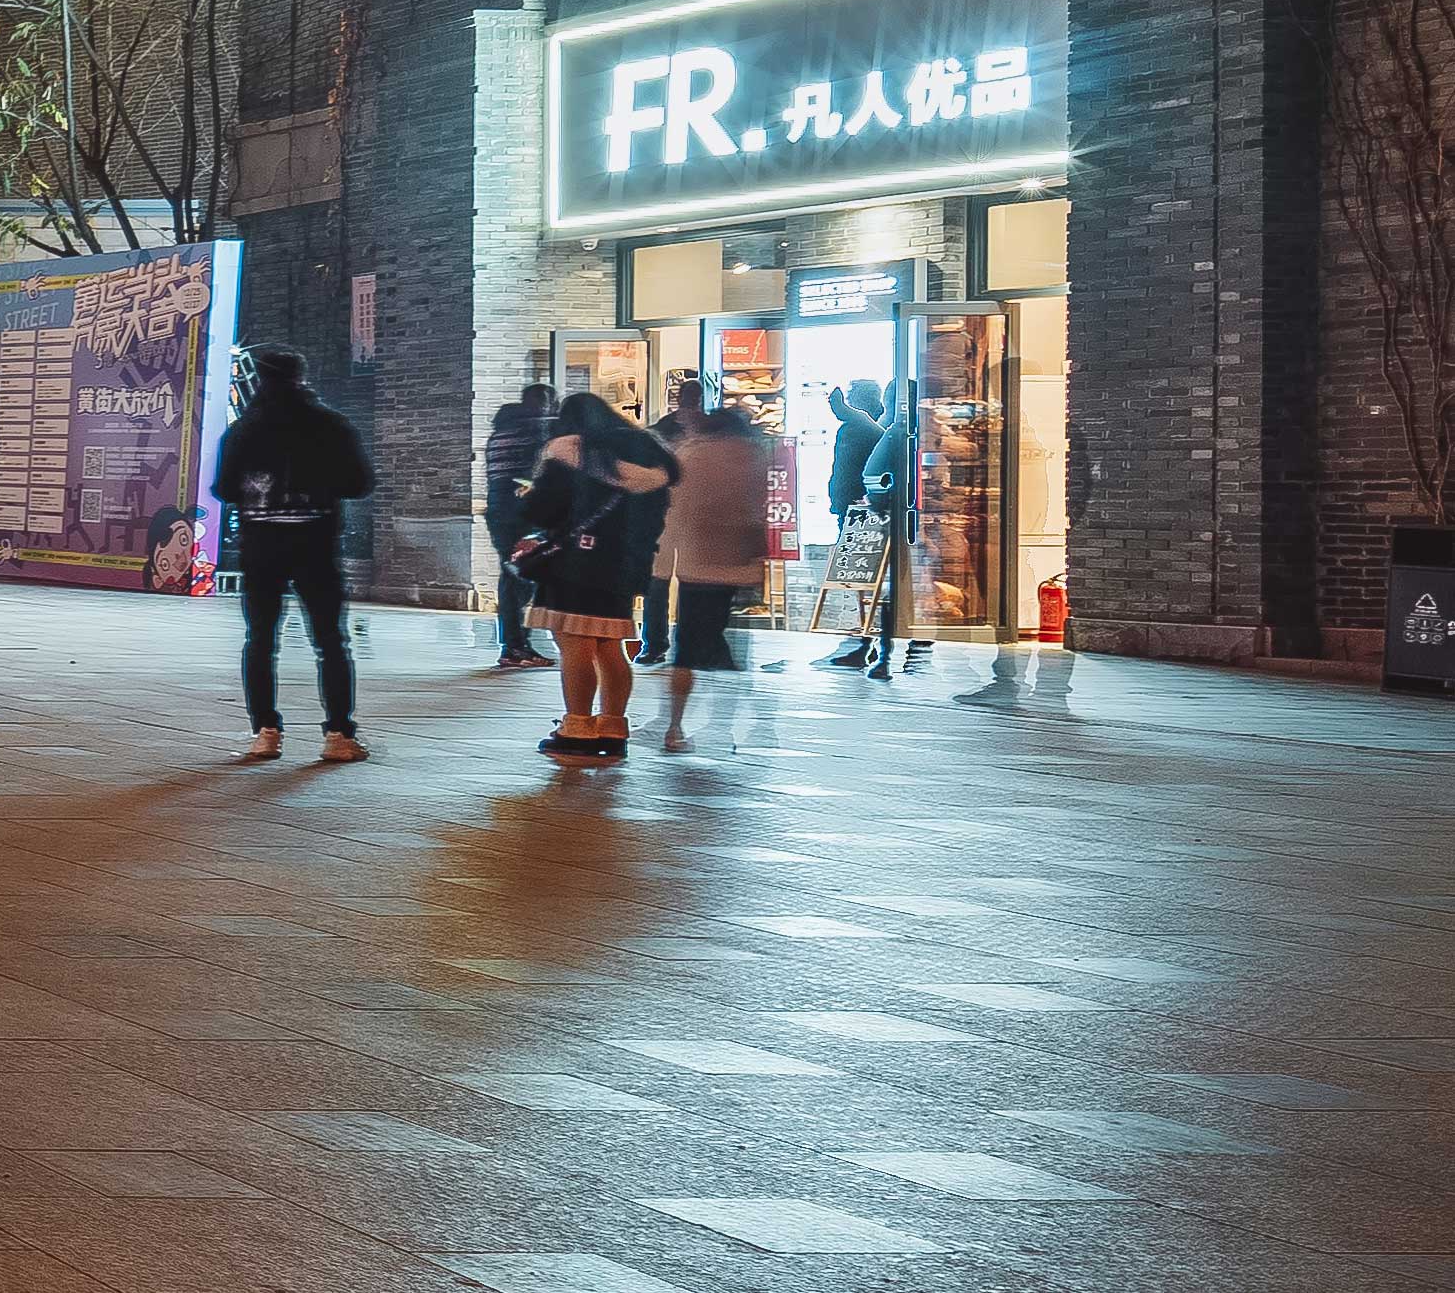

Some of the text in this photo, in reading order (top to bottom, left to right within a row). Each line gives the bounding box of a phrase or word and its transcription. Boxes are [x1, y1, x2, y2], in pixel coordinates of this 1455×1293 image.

[783, 46, 1033, 144] 凡人优品
[4, 302, 60, 331] STREET
